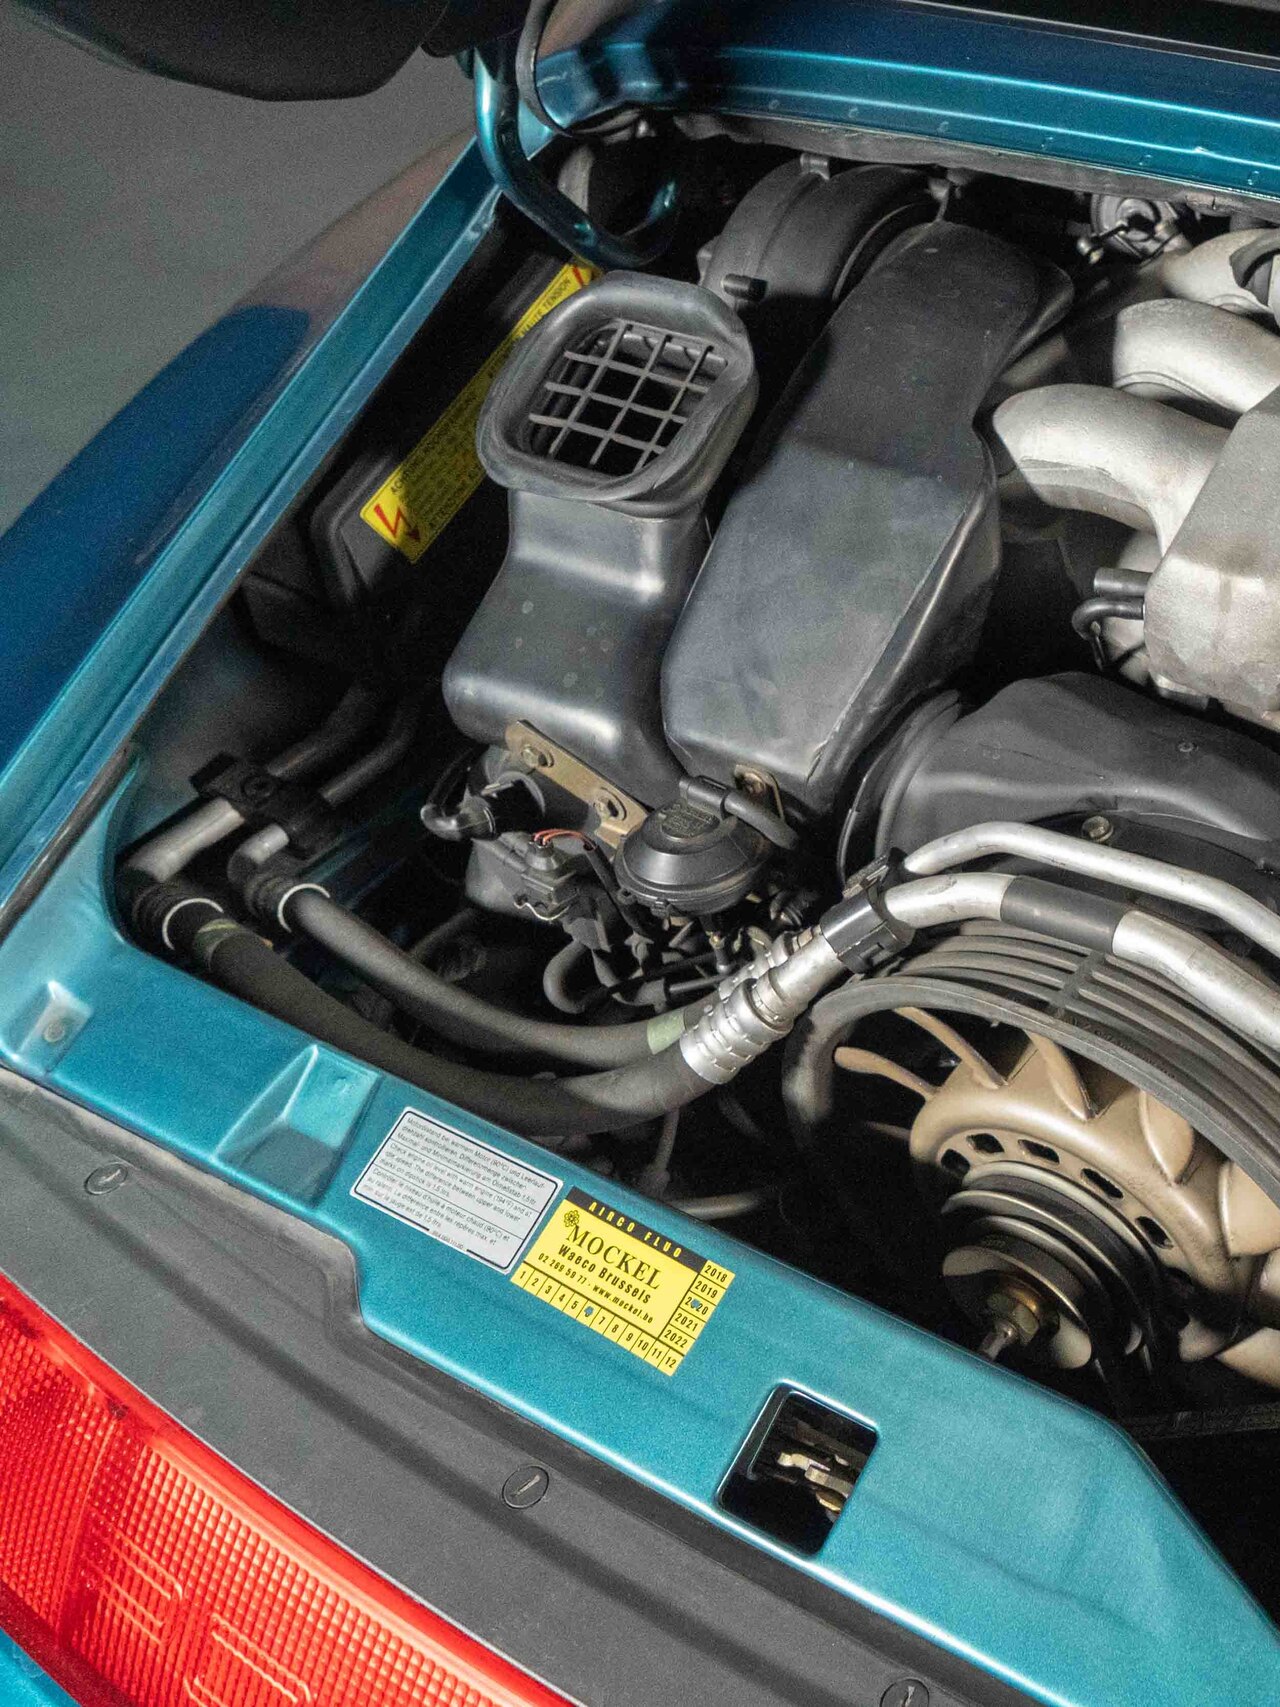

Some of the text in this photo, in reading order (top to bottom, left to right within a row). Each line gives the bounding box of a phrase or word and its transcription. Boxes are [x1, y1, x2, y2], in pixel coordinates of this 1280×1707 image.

[419, 1144, 432, 1154] und
[472, 1149, 492, 1163] Motor
[509, 1167, 522, 1178] und
[388, 1142, 407, 1156] Check
[405, 1151, 426, 1166] engine
[423, 1160, 434, 1169] oil
[431, 1163, 446, 1175] level
[444, 1170, 459, 1182] with
[457, 1178, 474, 1190] warm
[472, 1184, 494, 1200] engine
[512, 1204, 525, 1215] and
[402, 1170, 426, 1186] dipstick
[411, 1164, 425, 1175] The
[422, 1170, 453, 1189] difference
[450, 1184, 477, 1201] between
[473, 1196, 493, 1210] upper
[491, 1204, 505, 1215] and
[502, 1210, 521, 1223] lower
[500, 1173, 528, 1190] zwischen
[387, 1196, 406, 1211] jauge
[404, 1205, 414, 1214] est
[412, 1209, 424, 1219] de
[392, 1188, 403, 1198] La
[427, 1207, 445, 1220] entre
[443, 1215, 454, 1224] les
[403, 1183, 423, 1197] niveau
[444, 1204, 467, 1220] moteur
[464, 1214, 485, 1229] chaud
[587, 1200, 683, 1258] AIRCO FLUO
[564, 1223, 666, 1290] MOCKEL
[537, 1252, 549, 1263] 02
[548, 1258, 565, 1272] 269
[564, 1267, 577, 1279] 59
[575, 1274, 587, 1285] 77
[591, 1283, 654, 1324] www.mockel.be
[556, 1244, 652, 1304] Waeco Brussels
[693, 1280, 718, 1299] 2019
[703, 1264, 728, 1283] 2018
[519, 1270, 677, 1368] 1 2 3 4 5 7 8 9 10 11 12
[673, 1312, 699, 1331] 2021
[663, 1328, 688, 1348] 2022
